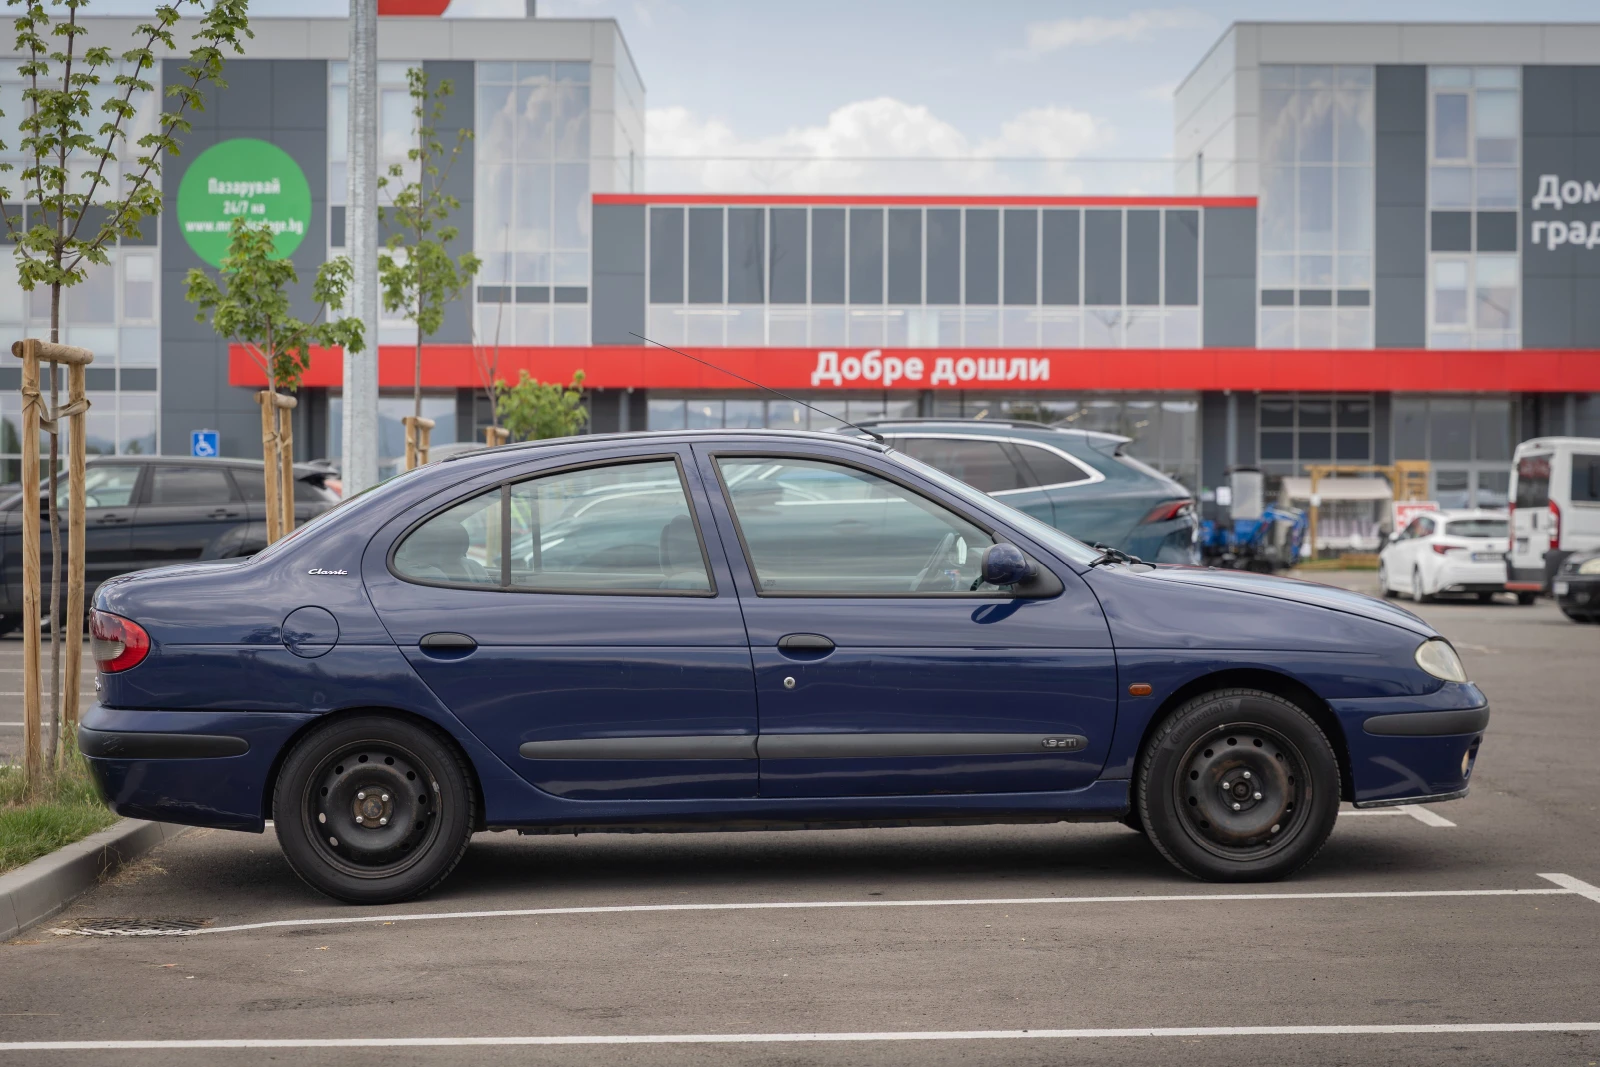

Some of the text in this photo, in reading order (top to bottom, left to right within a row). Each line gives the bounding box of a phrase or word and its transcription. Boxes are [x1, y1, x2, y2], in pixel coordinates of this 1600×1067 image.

[208, 177, 280, 197] Пазарувай
[222, 200, 266, 215] 24/7 на
[811, 349, 1050, 386] Добре дошли
[307, 567, 348, 576] Classic
